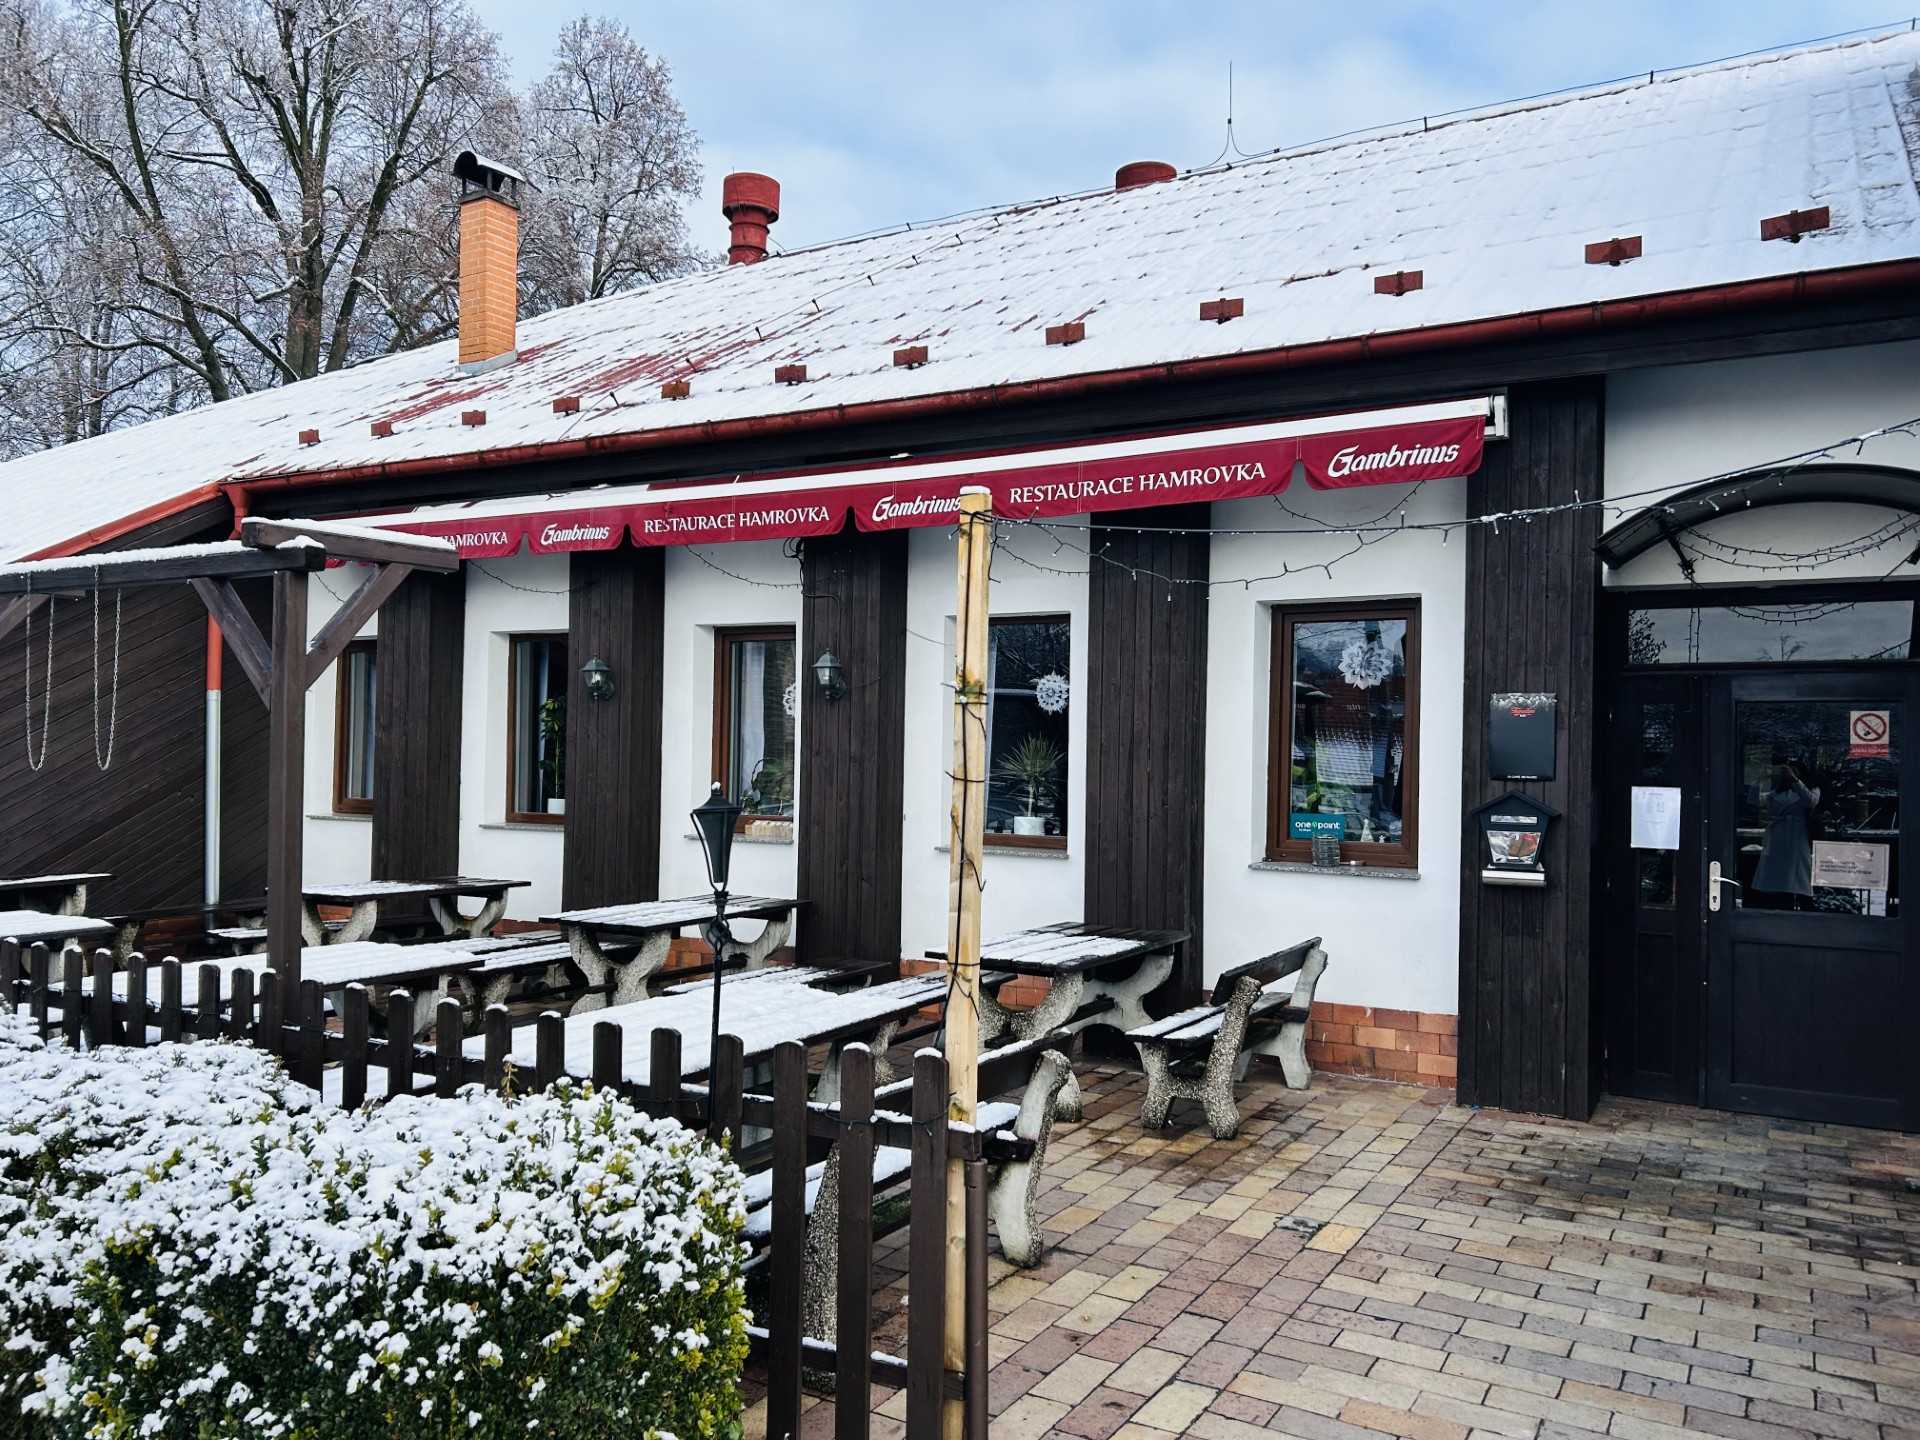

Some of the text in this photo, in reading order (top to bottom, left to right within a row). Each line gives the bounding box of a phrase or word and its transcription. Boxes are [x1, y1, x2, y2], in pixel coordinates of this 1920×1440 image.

[1327, 444, 1461, 478] Gambrinus
[1009, 462, 1266, 503] RESTAURACE HAMROVKA
[644, 506, 829, 533] RESTAURACE HAMROVKA
[872, 494, 960, 522] Gambrinus
[540, 523, 610, 546] Gambrinus
[1317, 821, 1340, 829] point
